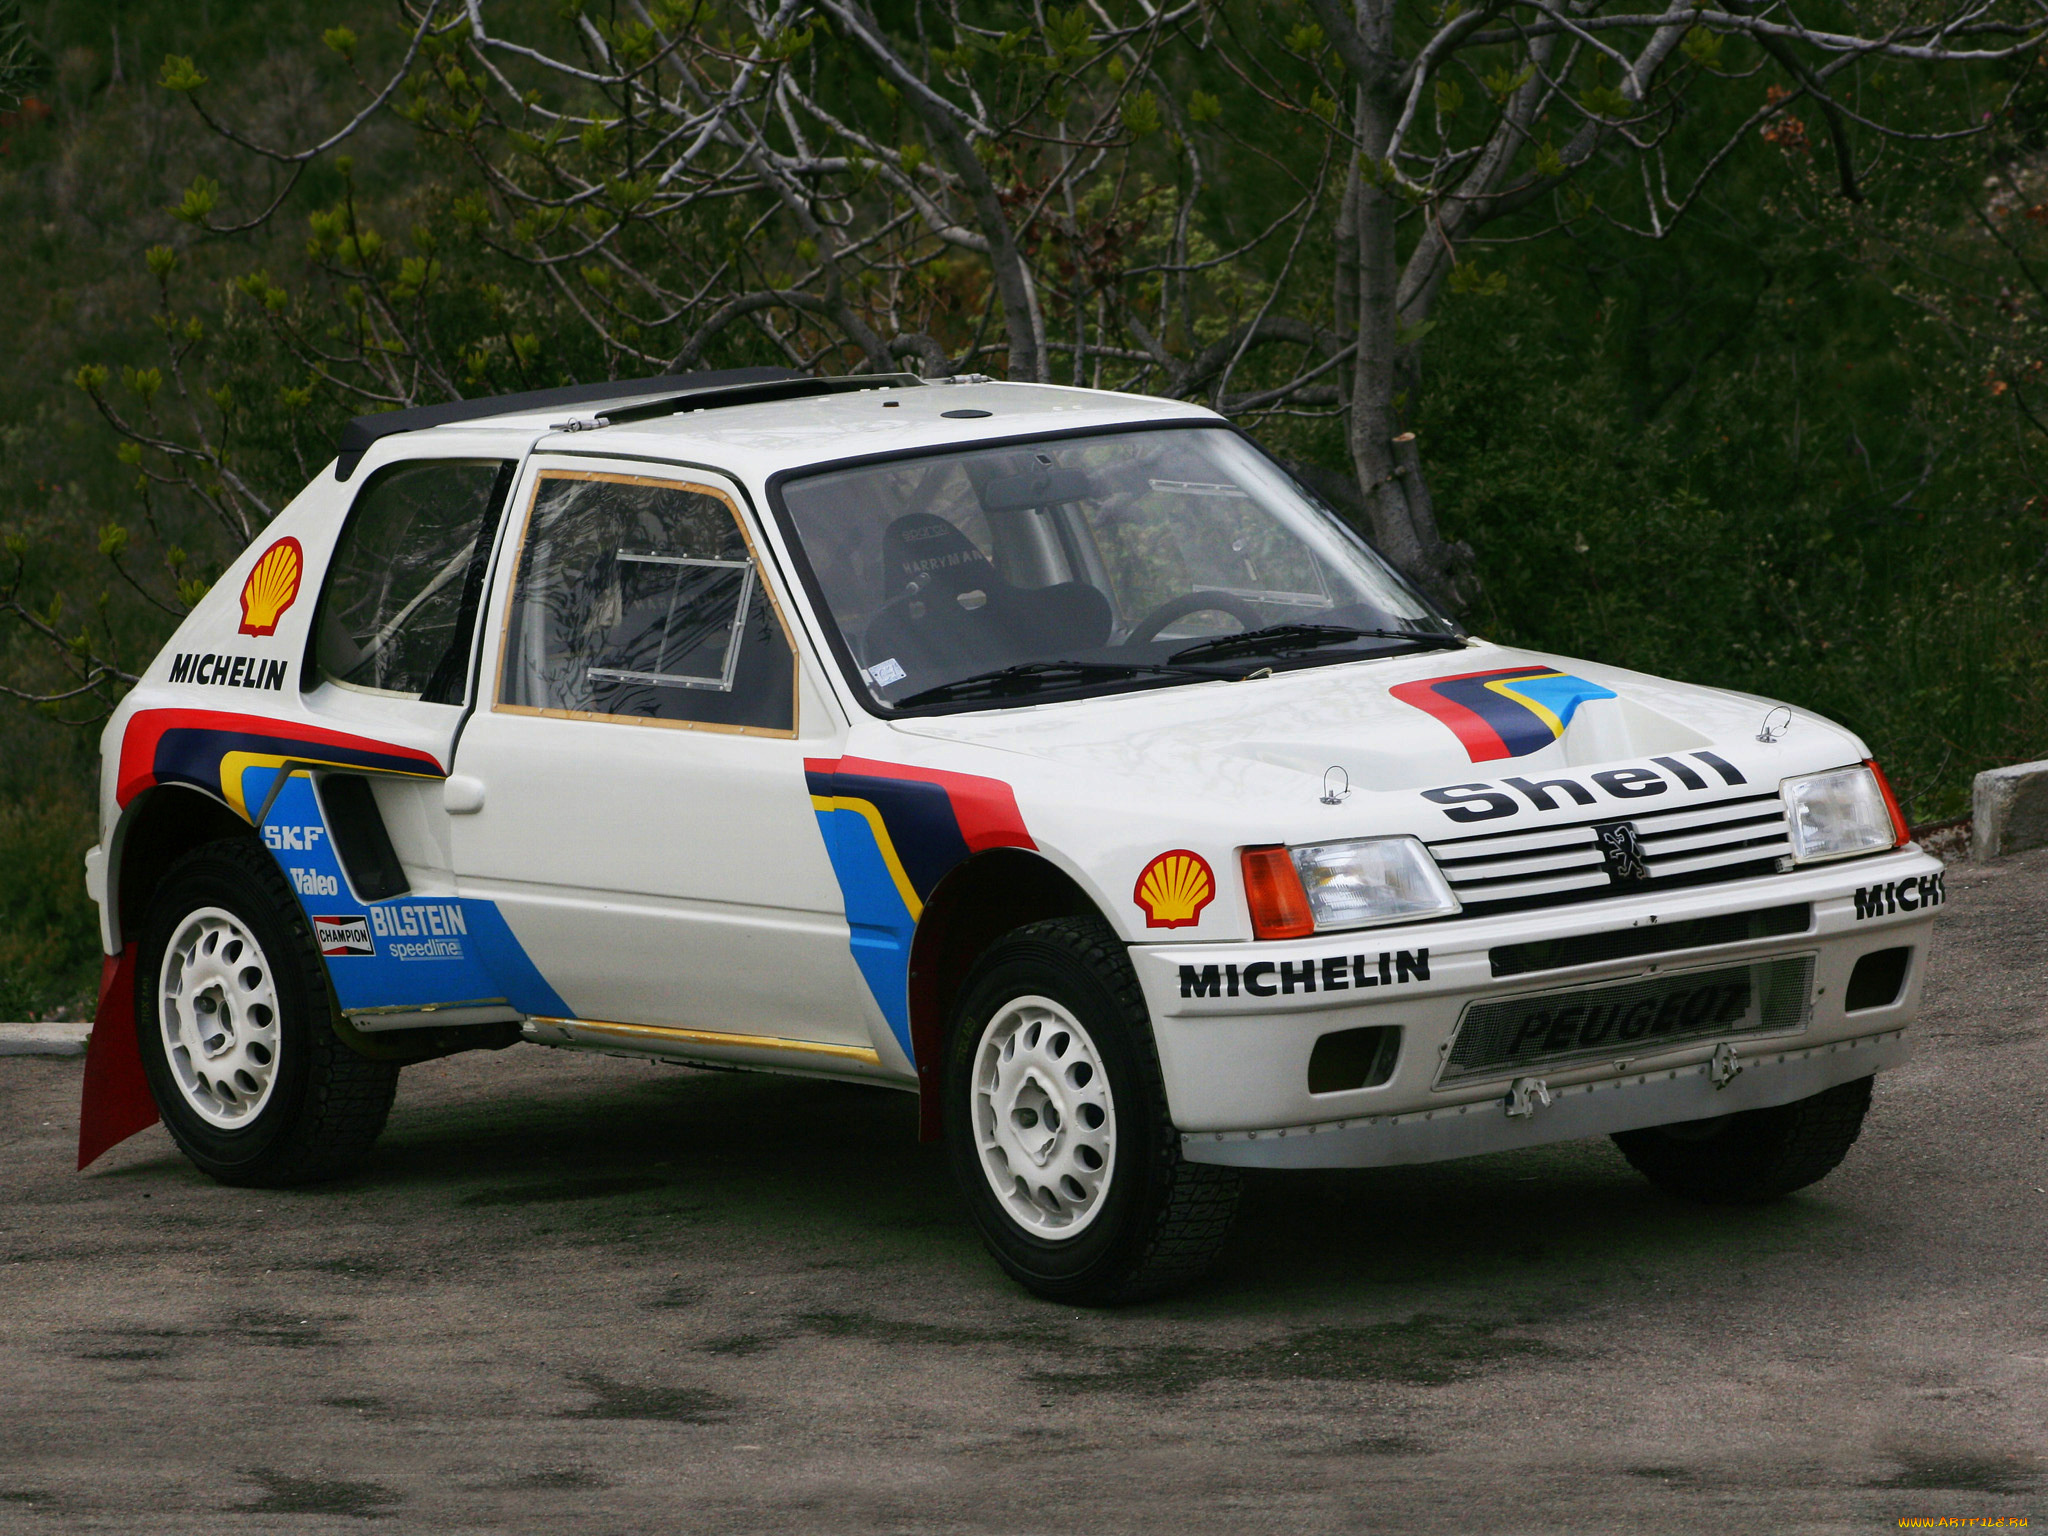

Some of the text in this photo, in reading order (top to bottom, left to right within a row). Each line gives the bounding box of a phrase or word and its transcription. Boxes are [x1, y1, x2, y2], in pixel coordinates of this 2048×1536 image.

[902, 549, 983, 575] HARRYMAN
[168, 653, 288, 691] MICHELIN
[1420, 751, 1747, 823] Shell
[264, 825, 324, 850] SKF
[290, 868, 338, 896] Valeo
[370, 905, 467, 936] BILSTEIN
[318, 928, 368, 943] CHAMPION
[389, 939, 459, 961] speedline
[1179, 948, 1430, 998] MICHELIN
[1508, 983, 1752, 1054] PEUGEOT
